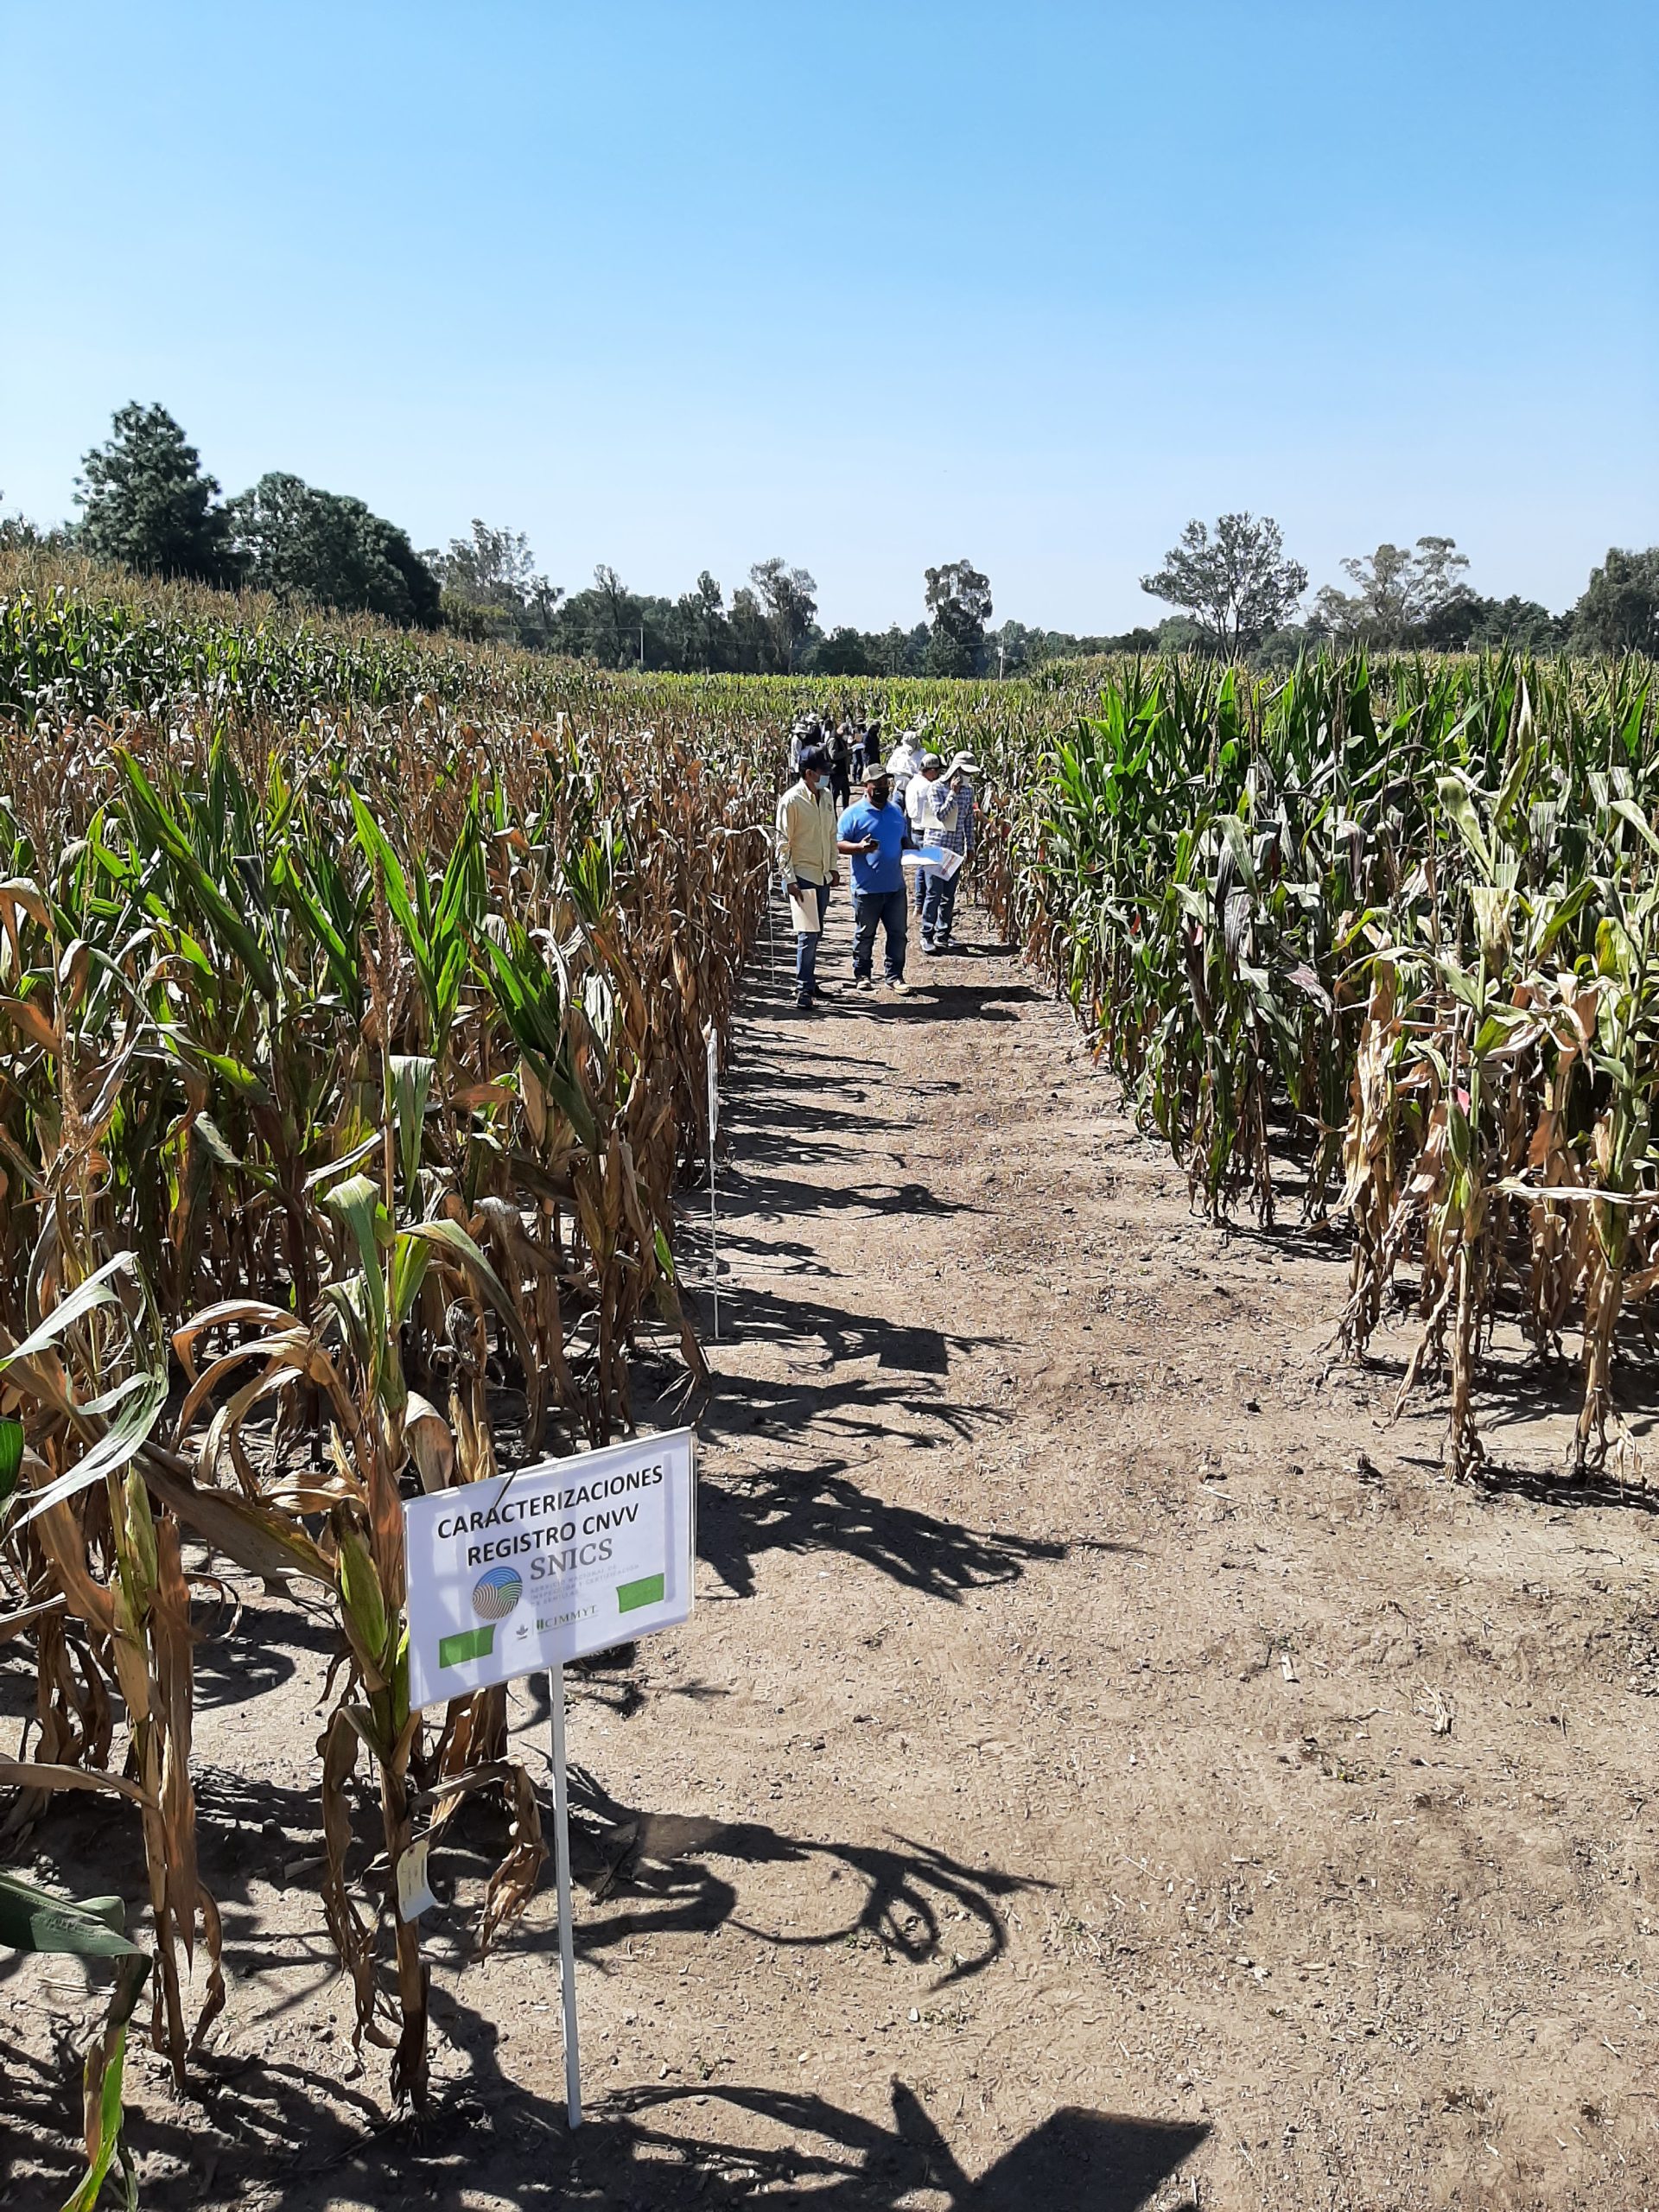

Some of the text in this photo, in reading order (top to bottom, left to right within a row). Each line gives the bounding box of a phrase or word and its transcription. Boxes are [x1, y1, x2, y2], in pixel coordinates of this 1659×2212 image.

[438, 1465, 663, 1539] CARACTERIZACIONES
[467, 1503, 639, 1566] REGISTRO CNVV
[531, 1538, 613, 1580] SNICS
[544, 1605, 597, 1628] CIMMYT
